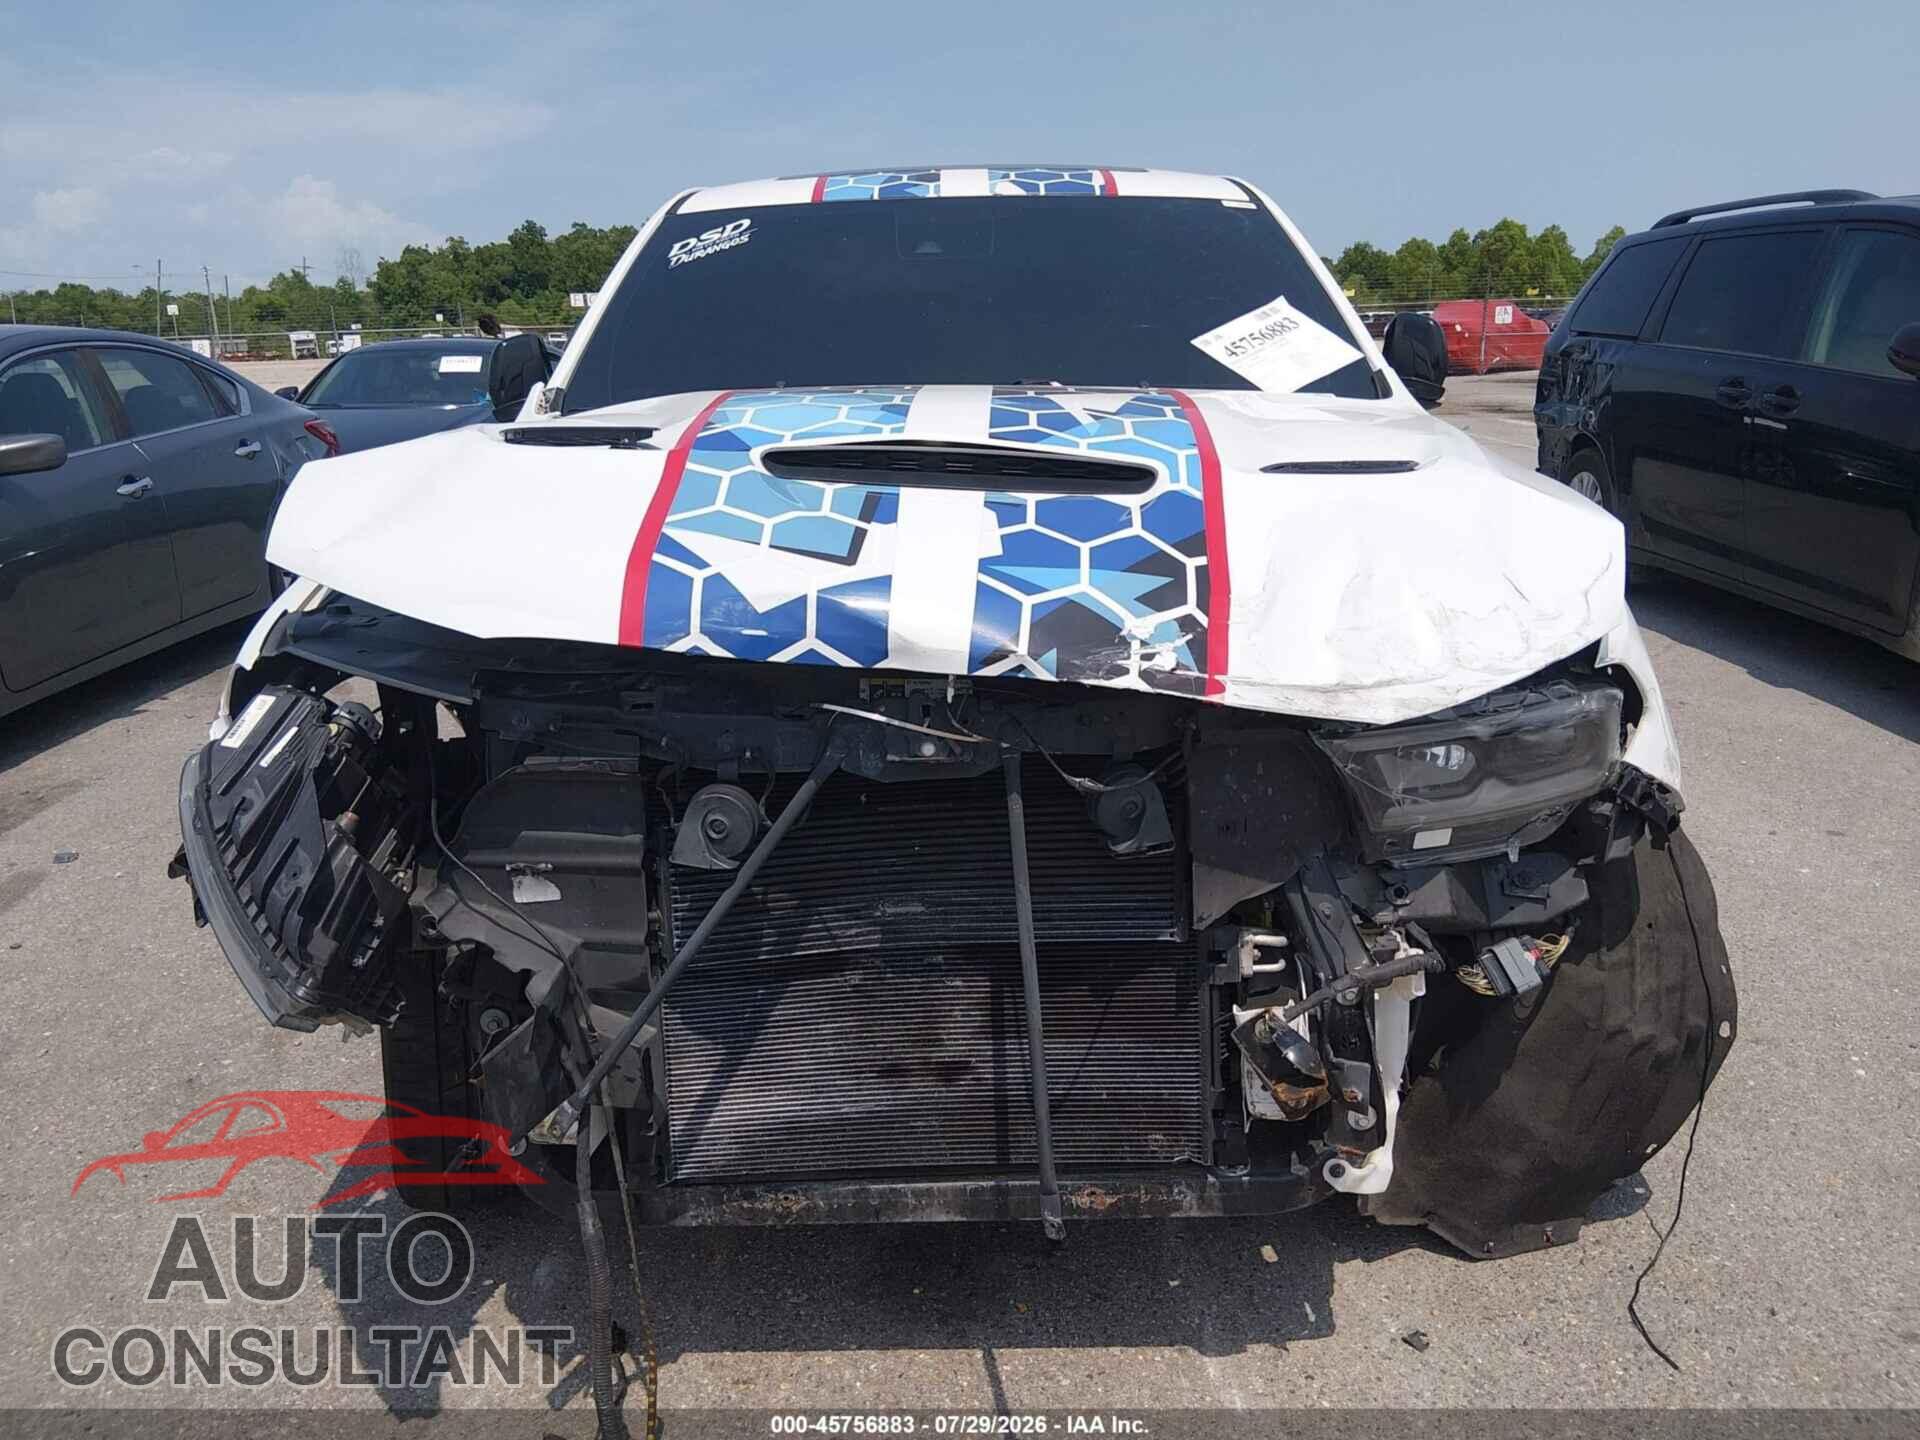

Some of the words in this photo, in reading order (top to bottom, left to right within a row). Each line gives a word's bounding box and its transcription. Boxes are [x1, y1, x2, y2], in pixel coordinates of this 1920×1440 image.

[667, 218, 752, 258] DSD
[668, 233, 752, 270] DURANGOS
[1223, 316, 1301, 359] 45756883
